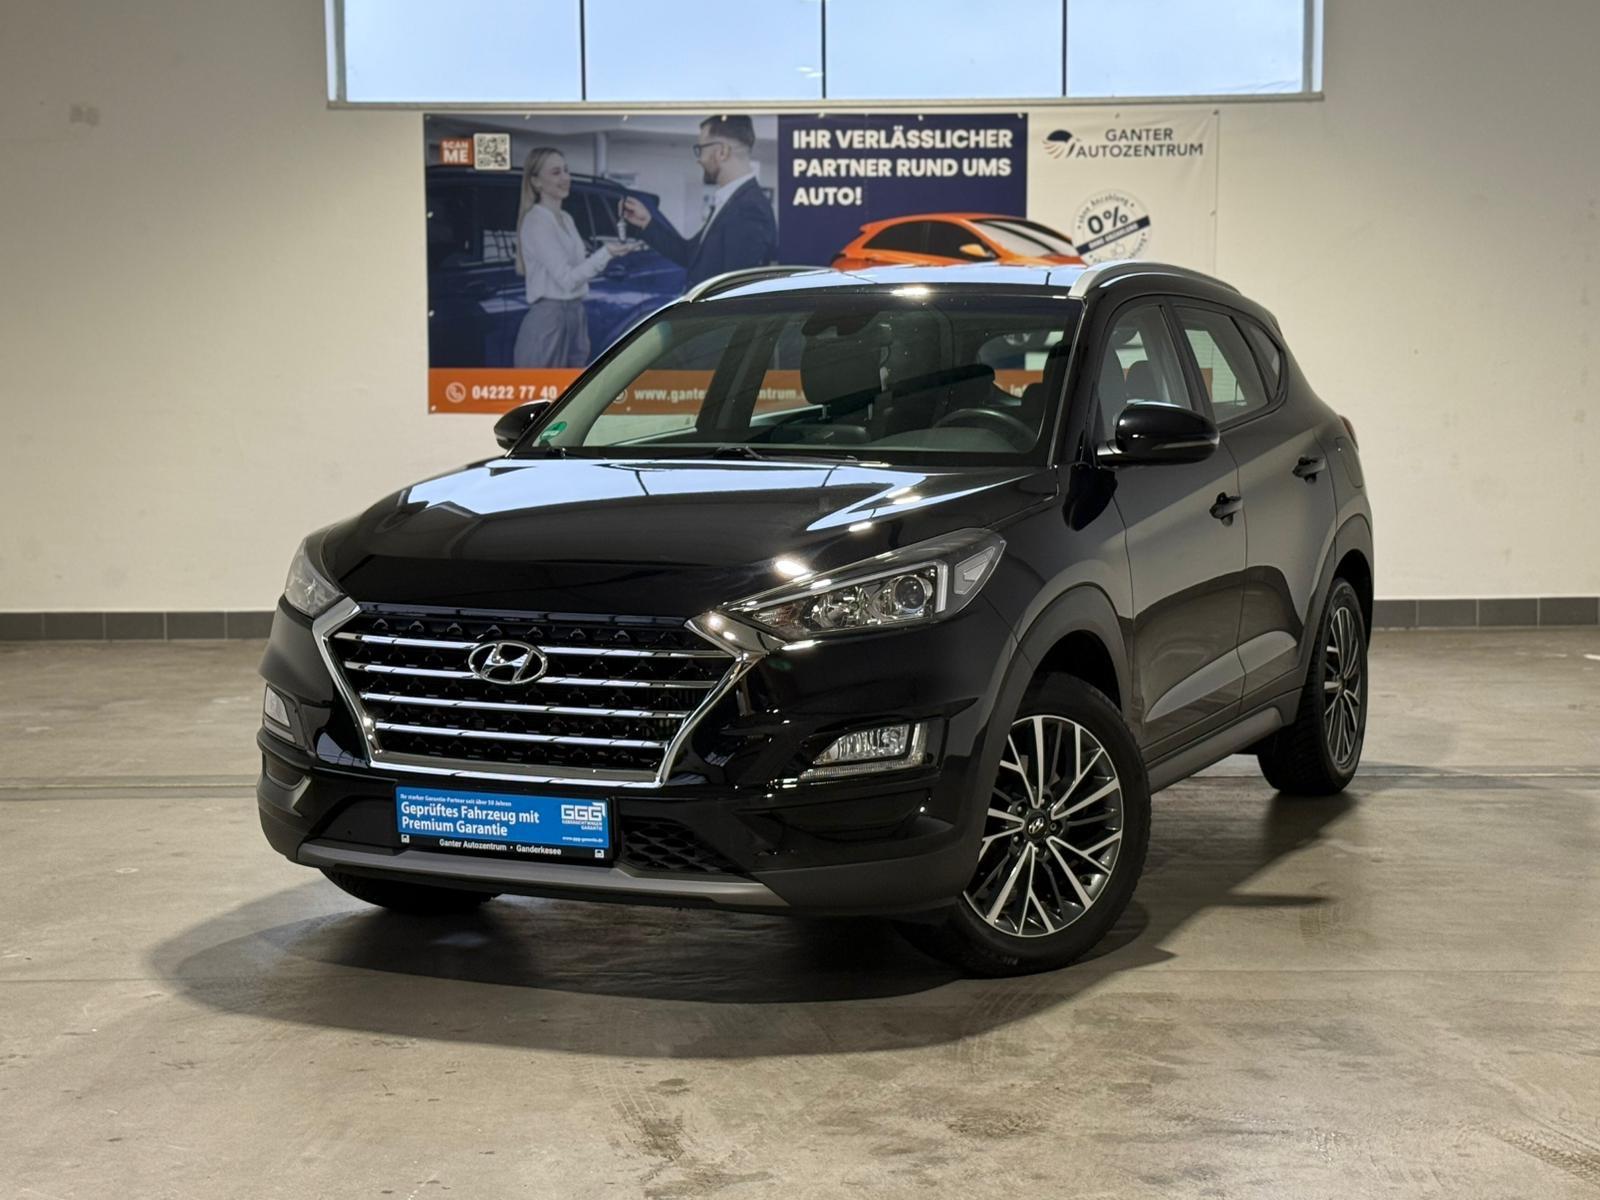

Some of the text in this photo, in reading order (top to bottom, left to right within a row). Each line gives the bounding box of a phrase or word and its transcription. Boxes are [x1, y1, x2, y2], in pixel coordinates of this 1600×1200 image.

[793, 125, 1013, 149] IHR VERLÄSSLICHER
[1105, 127, 1174, 142] GANTER
[441, 140, 469, 148] SCAN
[1076, 143, 1204, 159] AUTOZENTRUM
[443, 149, 469, 163] ME
[793, 158, 1012, 177] PARTNER RUND UMS
[793, 186, 862, 206] AUTO!
[1087, 205, 1129, 235] 0%
[472, 385, 515, 400] 04222
[519, 385, 536, 400] 77
[401, 801, 540, 825] Geprüftes Fahrzeug mit
[560, 804, 603, 821] GGG
[401, 816, 508, 836] Premium Garantie
[439, 838, 562, 856] Ganter Autozentrum Ganderkesee
